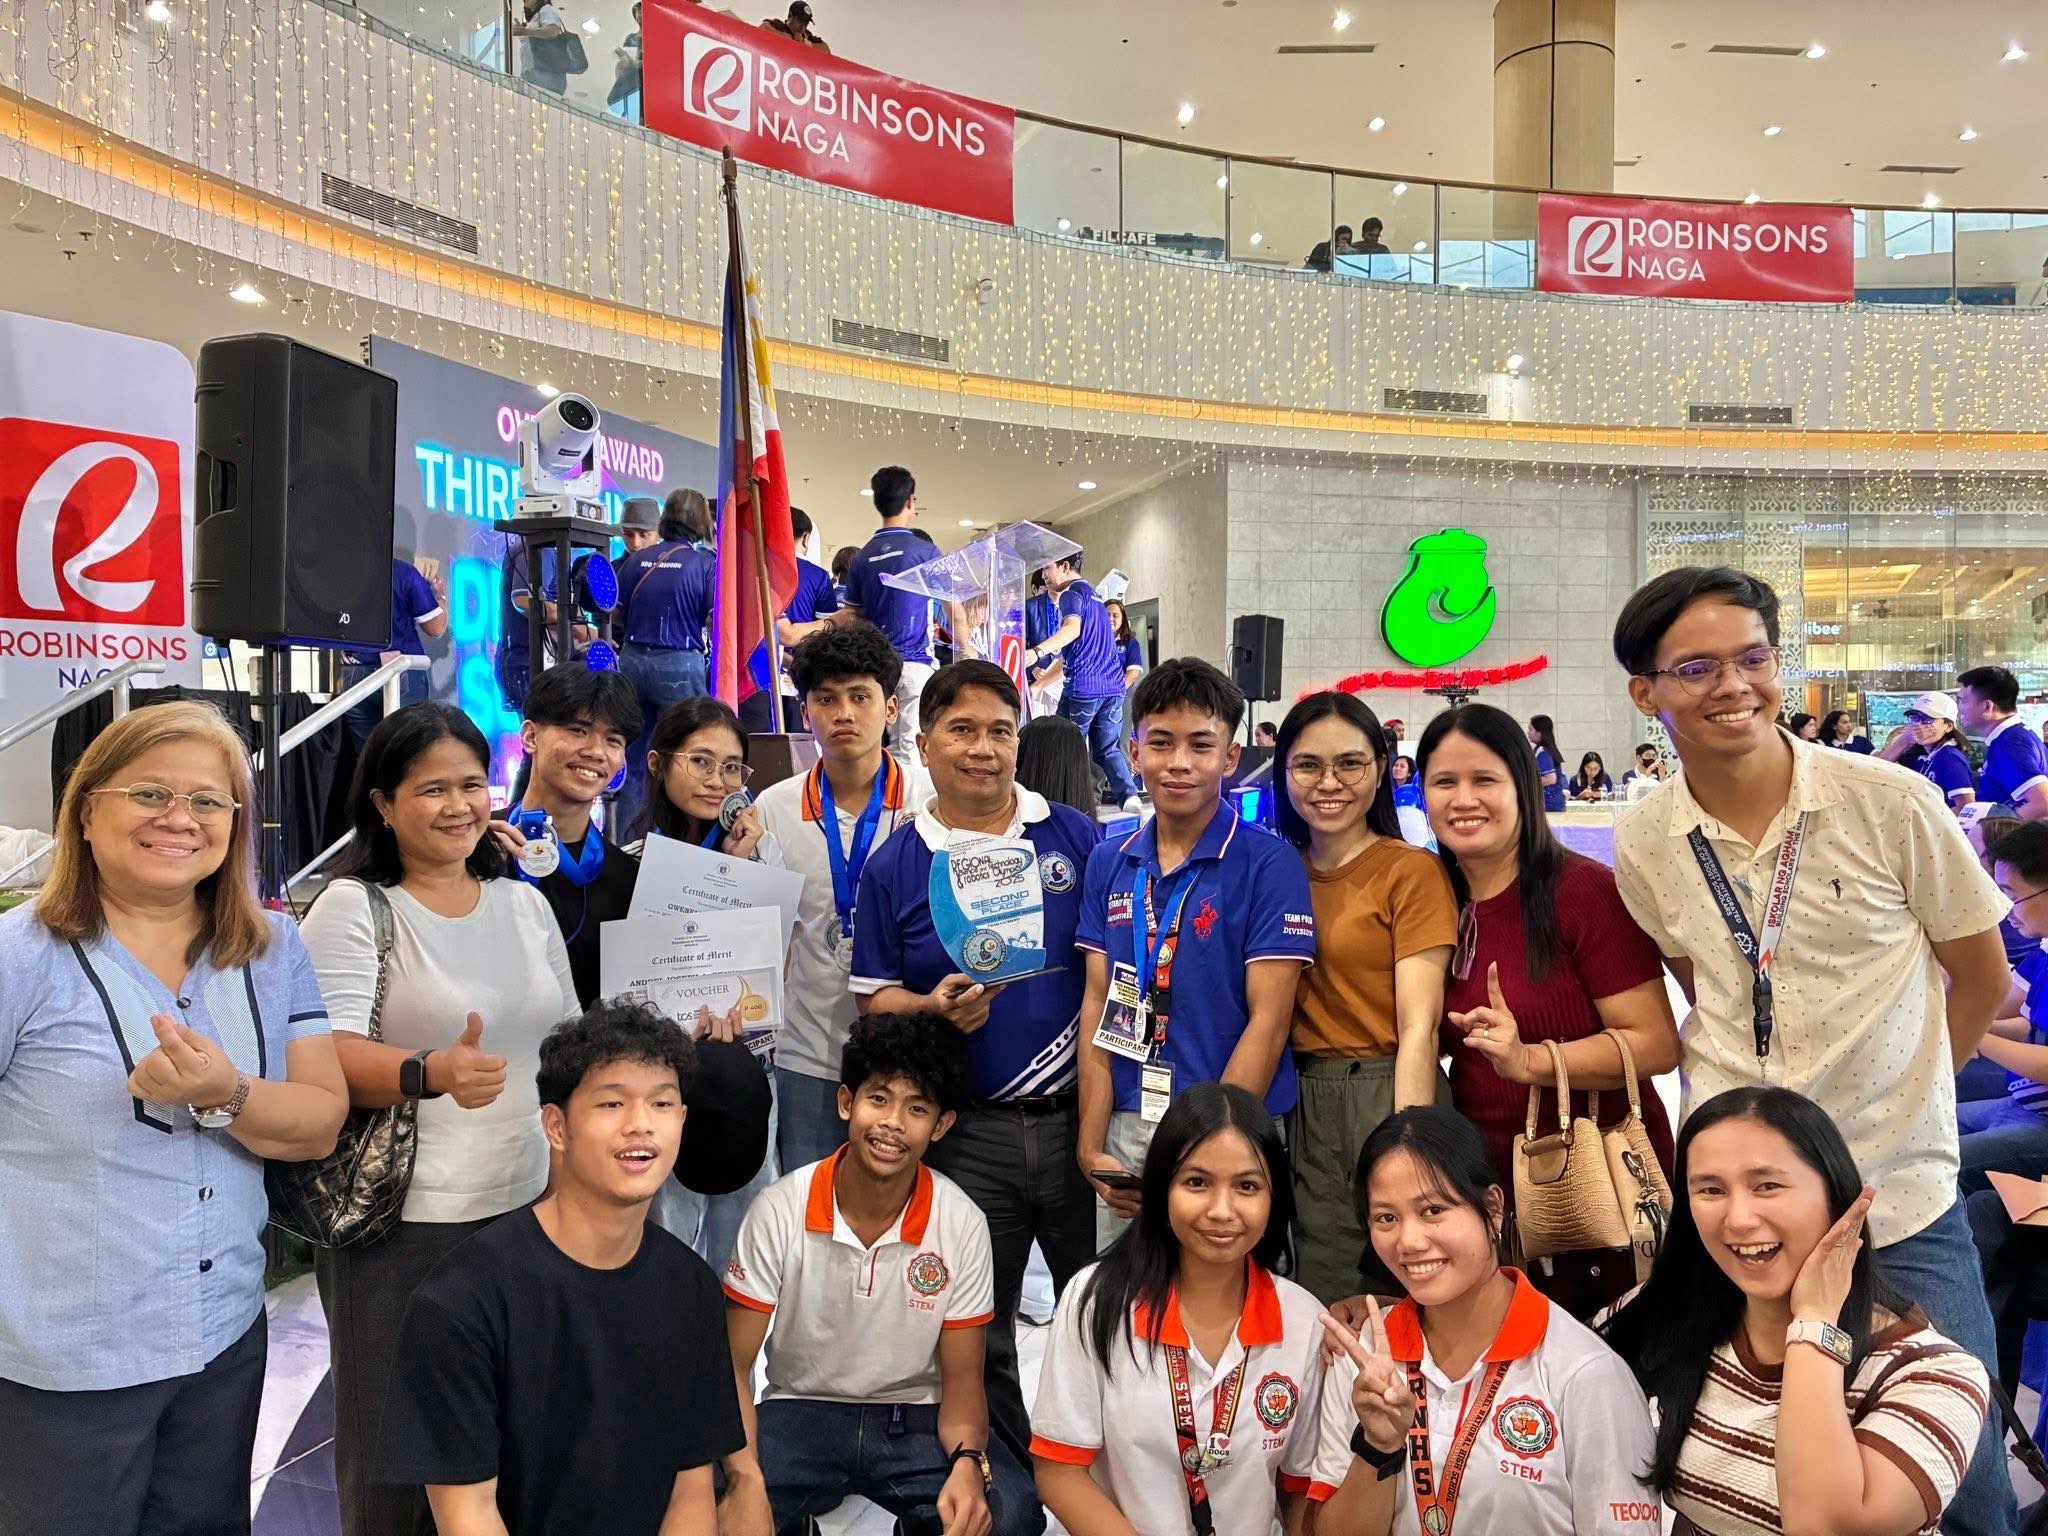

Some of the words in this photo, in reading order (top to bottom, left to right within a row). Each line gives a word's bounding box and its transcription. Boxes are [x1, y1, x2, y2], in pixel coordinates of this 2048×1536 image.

[758, 56, 986, 156] ROBINSONS
[757, 107, 850, 162] NAGA
[1628, 218, 1829, 254] ROBINSONS
[1627, 255, 1706, 282] NAGA
[1803, 621, 1842, 635] libee
[0, 630, 188, 662] ROBINSONS
[58, 667, 134, 689] NA
[1780, 831, 1795, 867] AGHAM
[1776, 897, 1787, 927] BUILDING
[1782, 858, 1795, 894] SCHOLARS
[1790, 848, 1797, 857] OF
[1777, 870, 1786, 884] NG
[682, 886, 719, 901] Certificate
[970, 890, 1030, 910] SECOND
[1704, 863, 1715, 880] DOST
[1712, 881, 1732, 916] SCHOLARS
[981, 901, 1022, 915] PLACE
[1719, 882, 1742, 923] INTEGRATED
[1767, 886, 1783, 927] ISKOLAR
[1284, 913, 1300, 923] TEAM
[1283, 926, 1313, 937] DIVISION
[651, 953, 694, 965] Certificate
[697, 952, 705, 961] of
[707, 950, 733, 960] Merit
[676, 984, 730, 998] VOUCHER
[747, 1034, 774, 1049] CIPANT
[1099, 1031, 1147, 1054] PARTICIPANT
[909, 1299, 934, 1311] STEM
[1176, 1381, 1193, 1427] STEM
[1484, 1378, 1501, 1409] RAFAEL
[1219, 1413, 1229, 1431] SAN
[1224, 1380, 1238, 1411] RAFAEL
[1465, 1409, 1486, 1448] NATIONAL
[1208, 1448, 1230, 1457] DOGS
[1262, 1437, 1285, 1450] STEM
[1455, 1449, 1468, 1472] HIGH
[1500, 1459, 1542, 1482] STEM
[1446, 1471, 1460, 1504] SCHOOL
